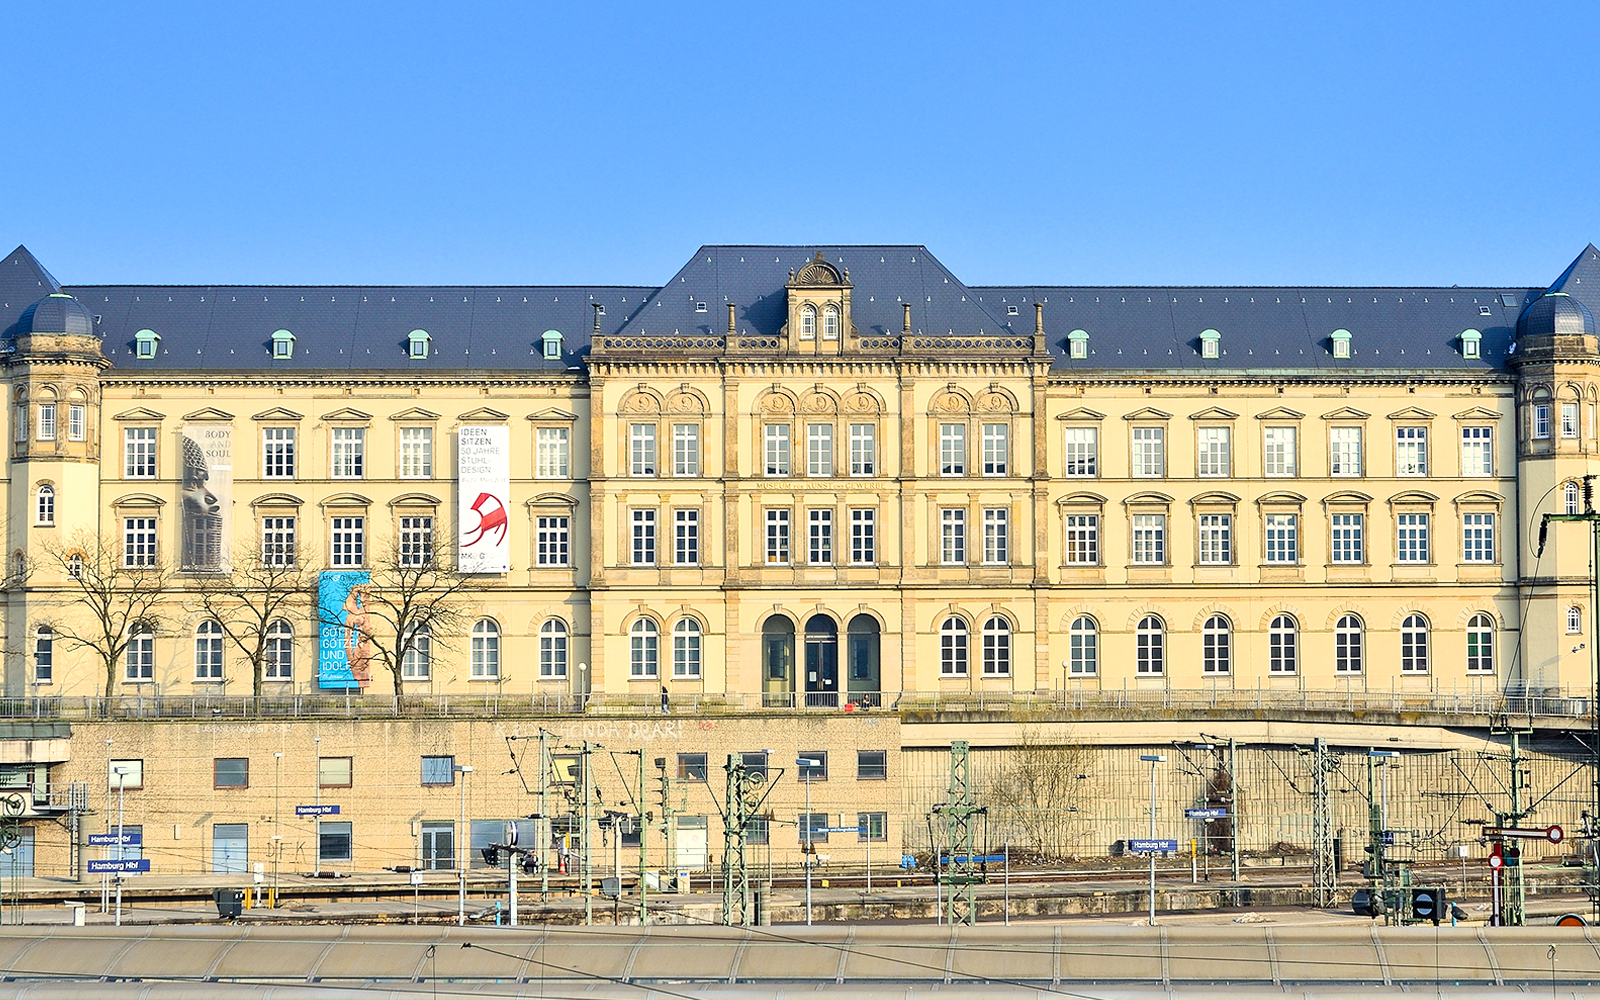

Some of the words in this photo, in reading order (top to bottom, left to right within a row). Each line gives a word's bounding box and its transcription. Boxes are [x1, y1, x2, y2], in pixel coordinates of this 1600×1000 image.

[205, 430, 231, 438] BODY
[461, 428, 487, 436] IDEEN
[210, 440, 231, 449] AND
[461, 437, 492, 446] SITZEN
[206, 450, 231, 458] SOUL
[461, 447, 471, 455] 50
[473, 447, 500, 455] JAHRE
[461, 466, 492, 474] DESIGN
[322, 650, 345, 660] UND
[322, 661, 351, 671] IDOLE
[91, 835, 119, 843] Hamburg
[91, 862, 124, 870] Hamburg
[126, 861, 139, 869] Hbf
